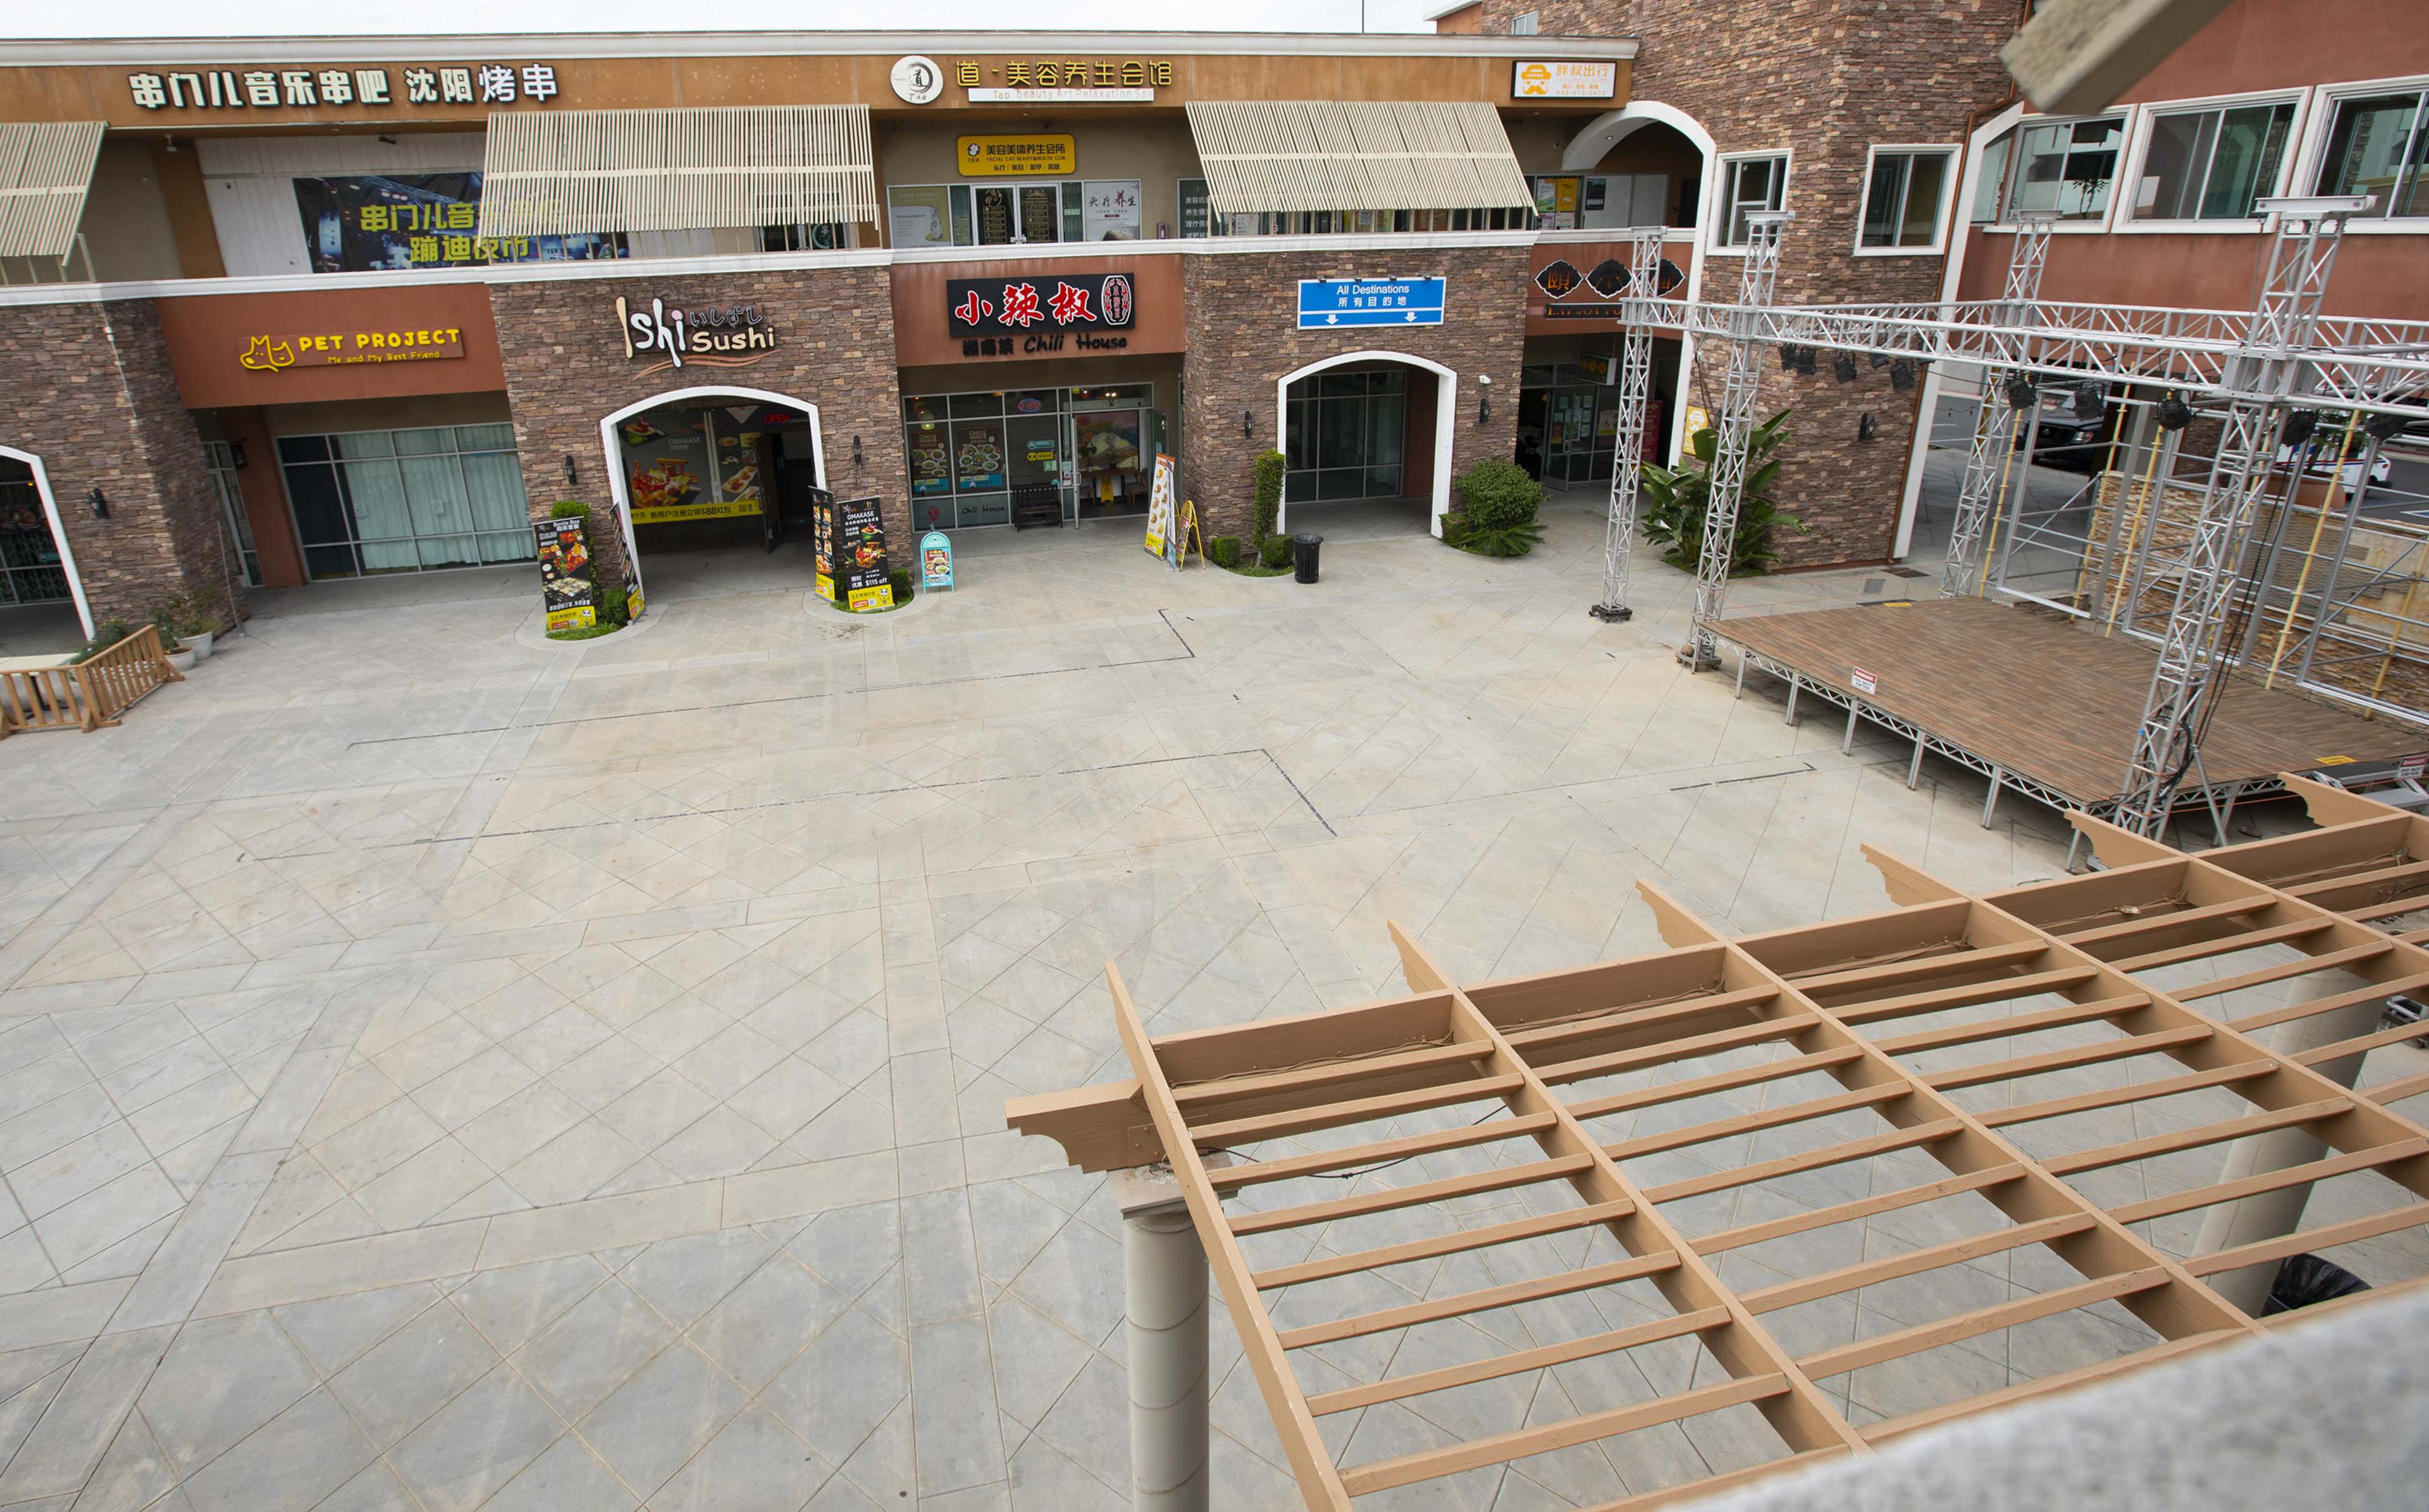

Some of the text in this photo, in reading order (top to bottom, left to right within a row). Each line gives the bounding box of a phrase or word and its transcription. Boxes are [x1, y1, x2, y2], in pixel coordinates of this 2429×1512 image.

[128, 63, 559, 109] 串门儿音乐串吧 沈阳烤串
[993, 90, 1010, 100] Tao
[1056, 89, 1073, 98] Art
[1076, 89, 1134, 98] Relaxation
[1135, 89, 1153, 99] Spa
[987, 144, 1065, 155] 美容美体养生会所
[1089, 190, 1136, 207] 头疗养生
[1337, 284, 1410, 295] All Destinations
[955, 281, 1097, 327] 小辣椒
[1338, 295, 1407, 307] 所有目的地
[299, 328, 460, 352] PET PROJECT
[692, 326, 775, 353] Sushi
[1023, 331, 1127, 353] Chili House
[328, 350, 441, 364] Me and My Best Friend
[669, 436, 700, 445] OMAKASE
[847, 510, 874, 520] OMAKASE
[961, 505, 978, 515] Chili
